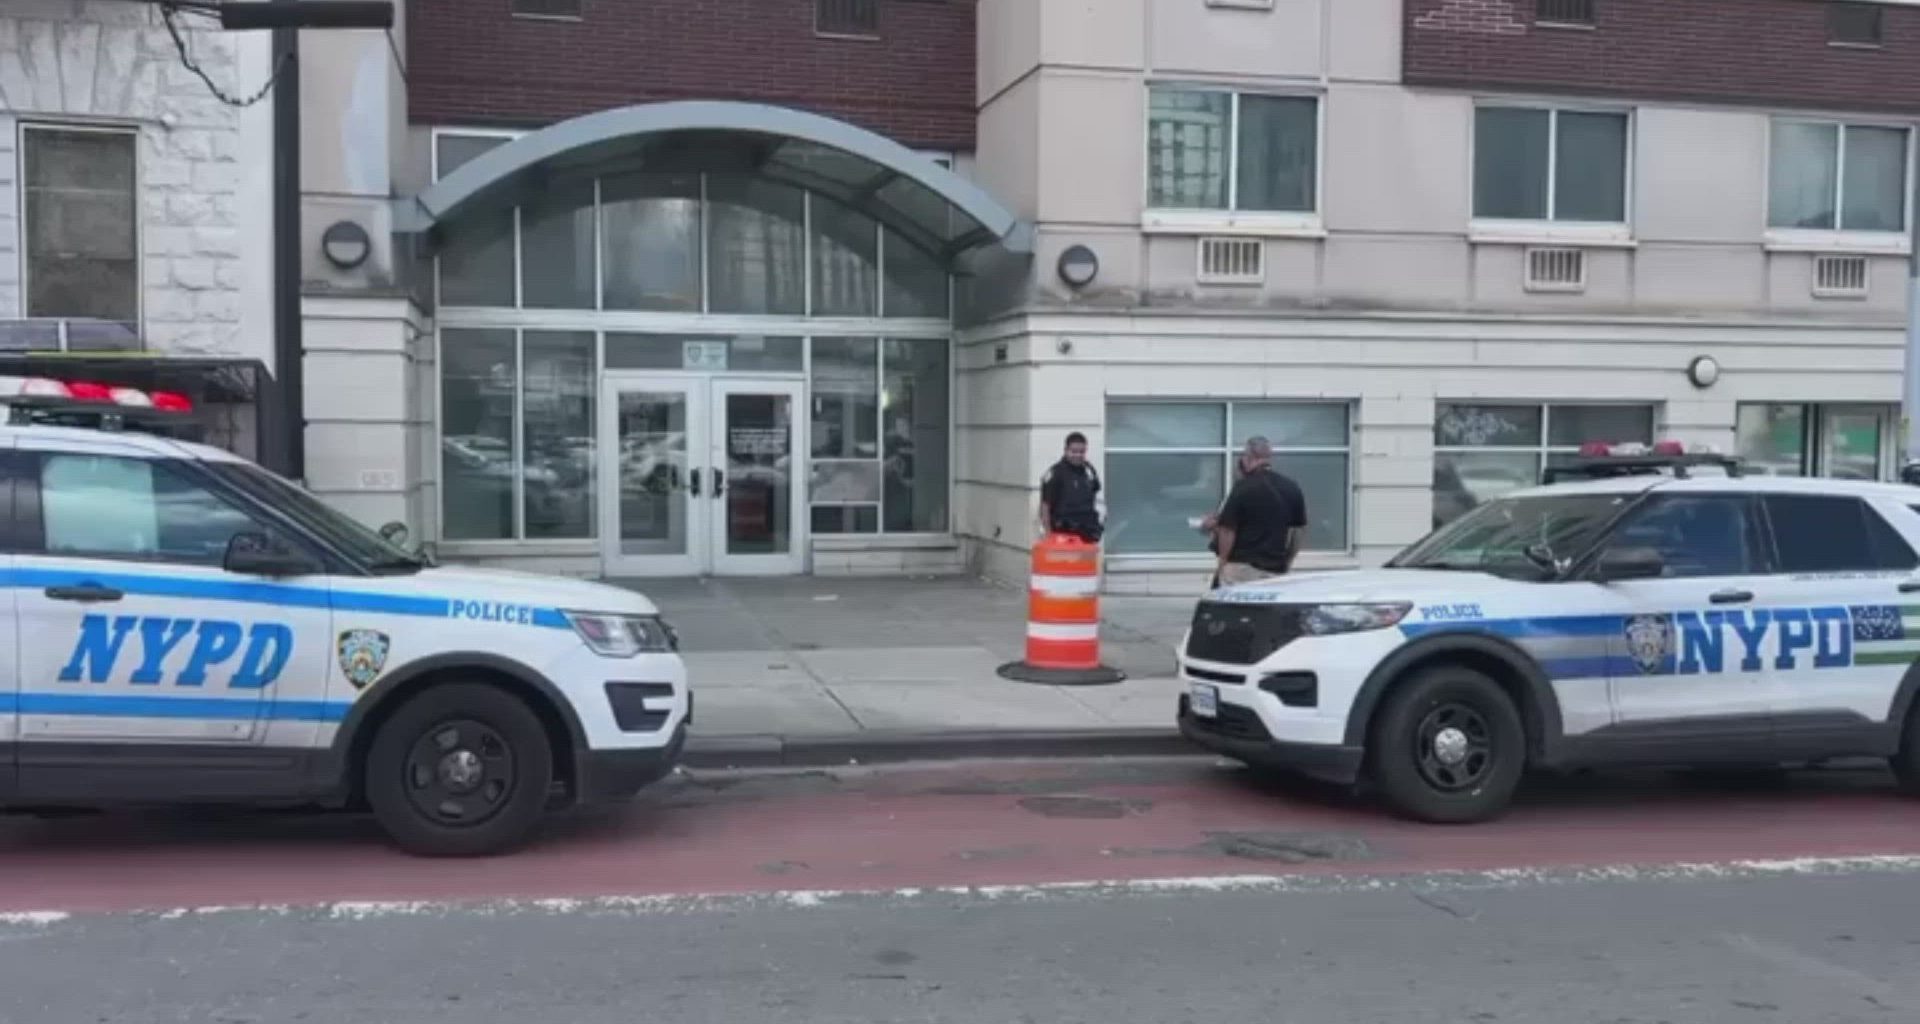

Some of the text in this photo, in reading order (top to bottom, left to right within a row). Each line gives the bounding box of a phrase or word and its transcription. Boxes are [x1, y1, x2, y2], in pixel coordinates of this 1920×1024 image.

[452, 599, 529, 625] POLICE
[1420, 603, 1483, 620] POLICE
[57, 613, 293, 688] NYPD
[1676, 605, 1851, 674] NYPD
